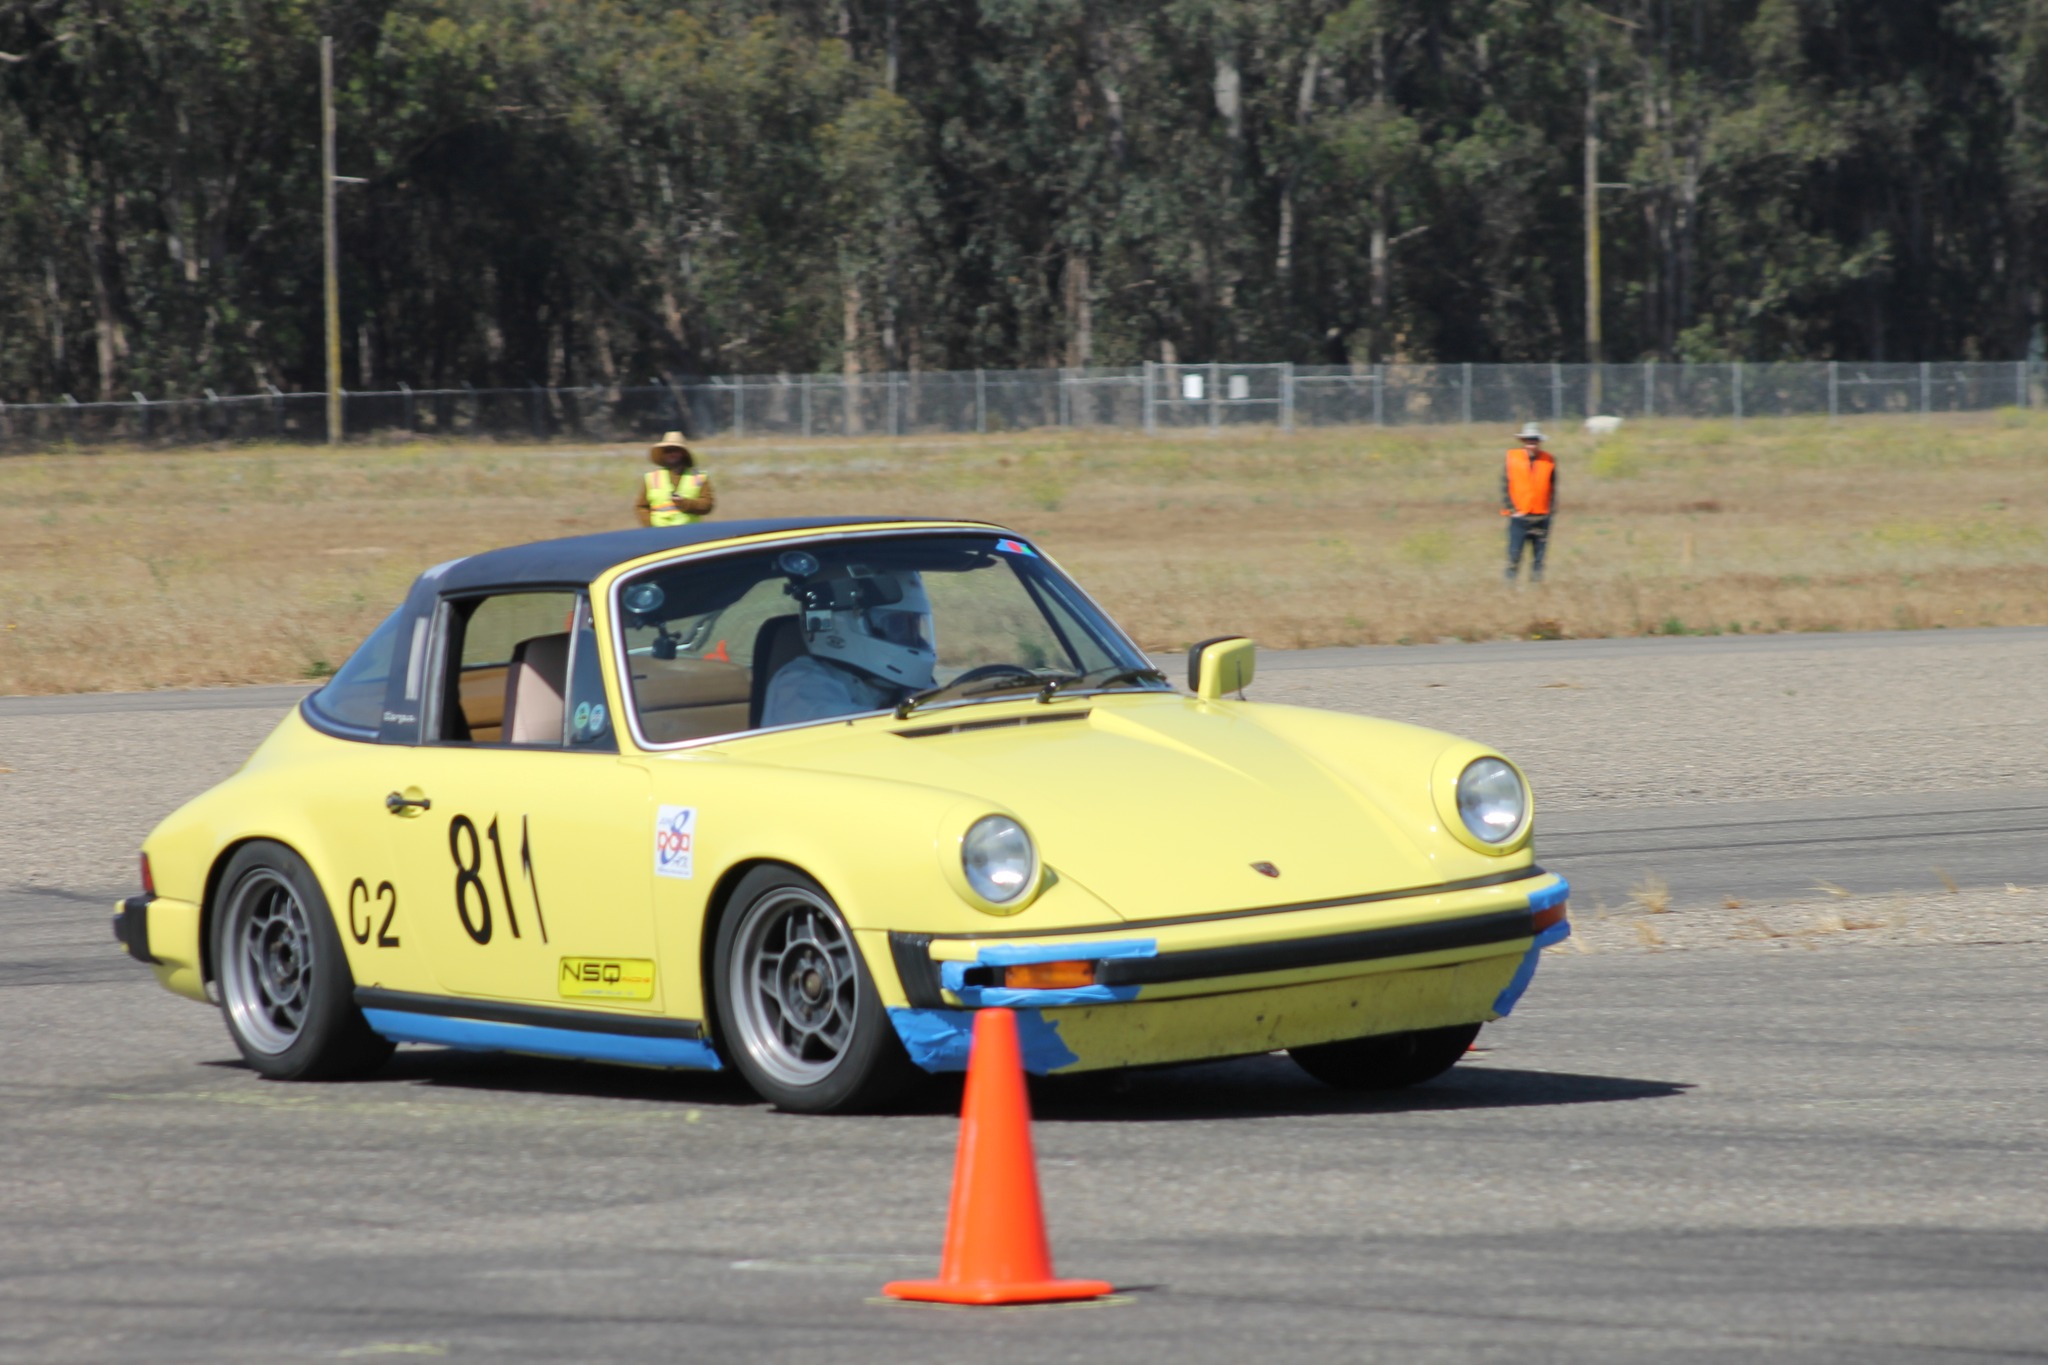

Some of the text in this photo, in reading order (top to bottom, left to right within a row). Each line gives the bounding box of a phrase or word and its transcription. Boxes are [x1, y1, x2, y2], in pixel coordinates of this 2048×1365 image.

[348, 877, 400, 948] C2
[448, 812, 549, 945] 811
[562, 962, 620, 985] NSQ
